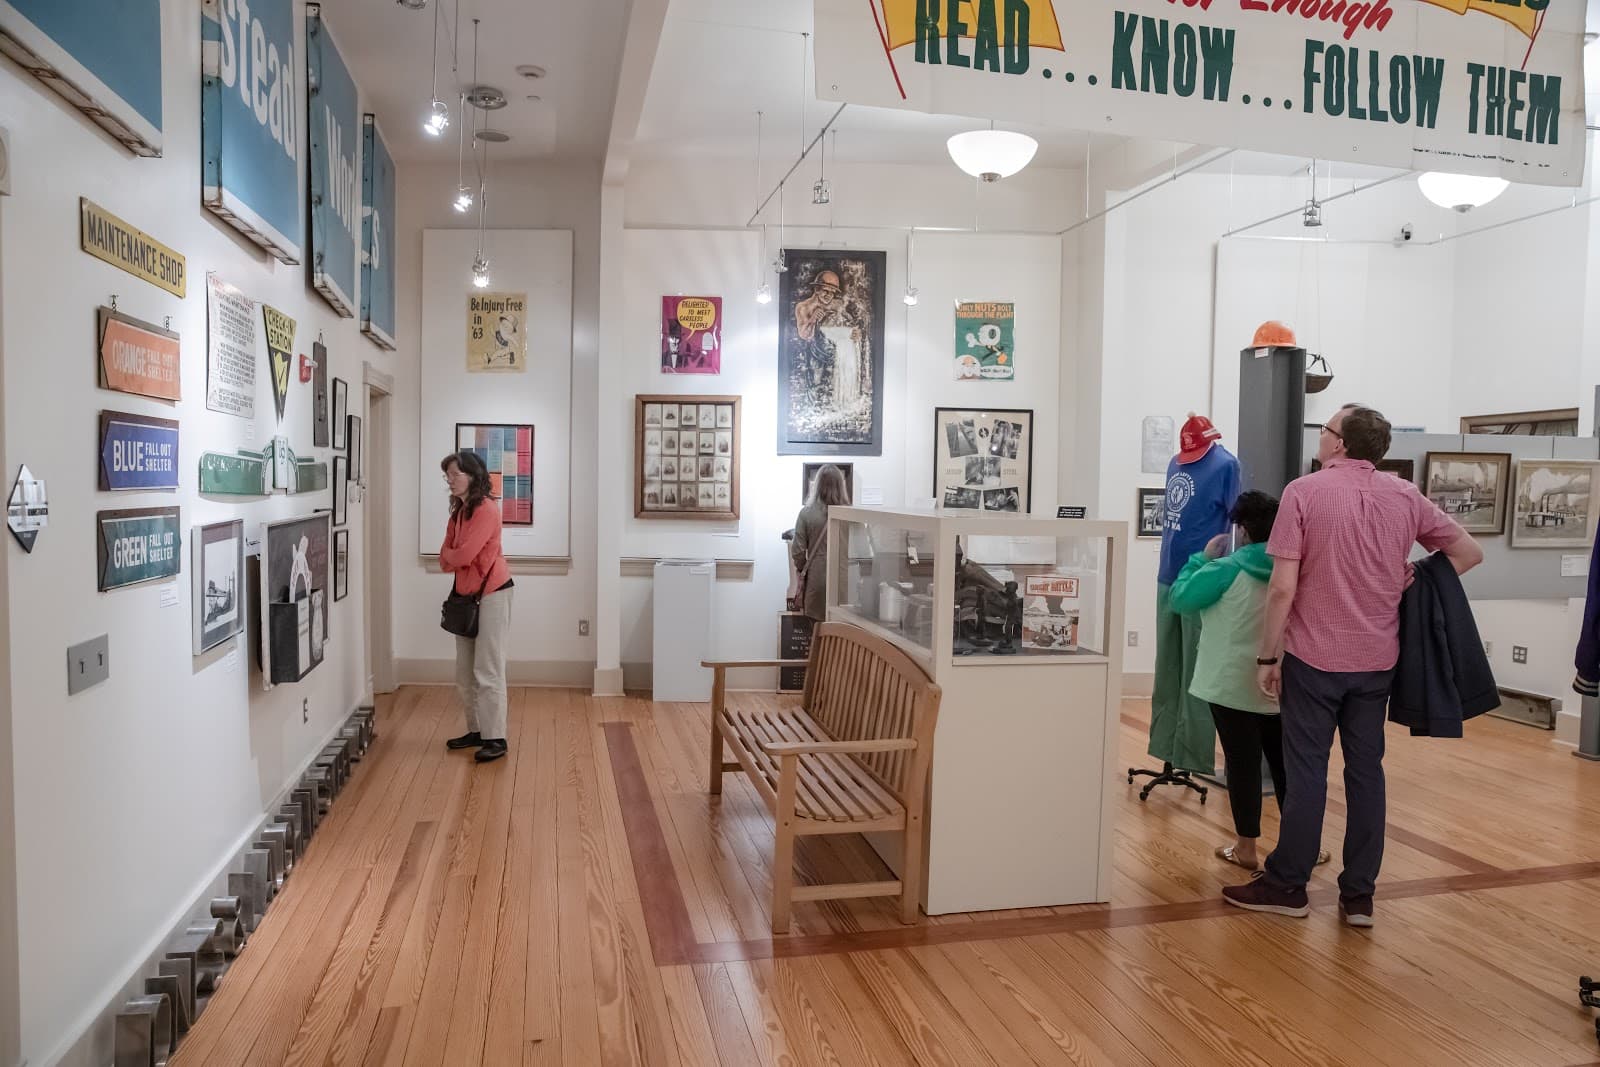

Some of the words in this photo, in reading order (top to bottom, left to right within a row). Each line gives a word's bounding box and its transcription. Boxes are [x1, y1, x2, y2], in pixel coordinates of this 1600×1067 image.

[914, 0, 1031, 75] READ
[1112, 10, 1236, 102] KNOW
[1303, 38, 1445, 129] FOLLOW
[1466, 62, 1562, 145] THEM
[87, 210, 158, 277] MAINTENANCE
[159, 251, 184, 289] SHOP
[470, 297, 480, 312] Be
[480, 296, 505, 314] Injury
[506, 297, 523, 312] Free
[681, 300, 709, 309] DELIGHTED
[974, 303, 997, 312] NUTS
[473, 313, 482, 325] in
[471, 326, 483, 340] '63
[113, 439, 144, 472] BLUE
[145, 442, 160, 456] FALL
[160, 443, 172, 457] OUT
[145, 458, 172, 472] SHELTER
[113, 535, 148, 569] GREEN
[149, 532, 162, 548] FALL
[163, 531, 174, 546] OUT
[149, 546, 174, 563] SHELTER
